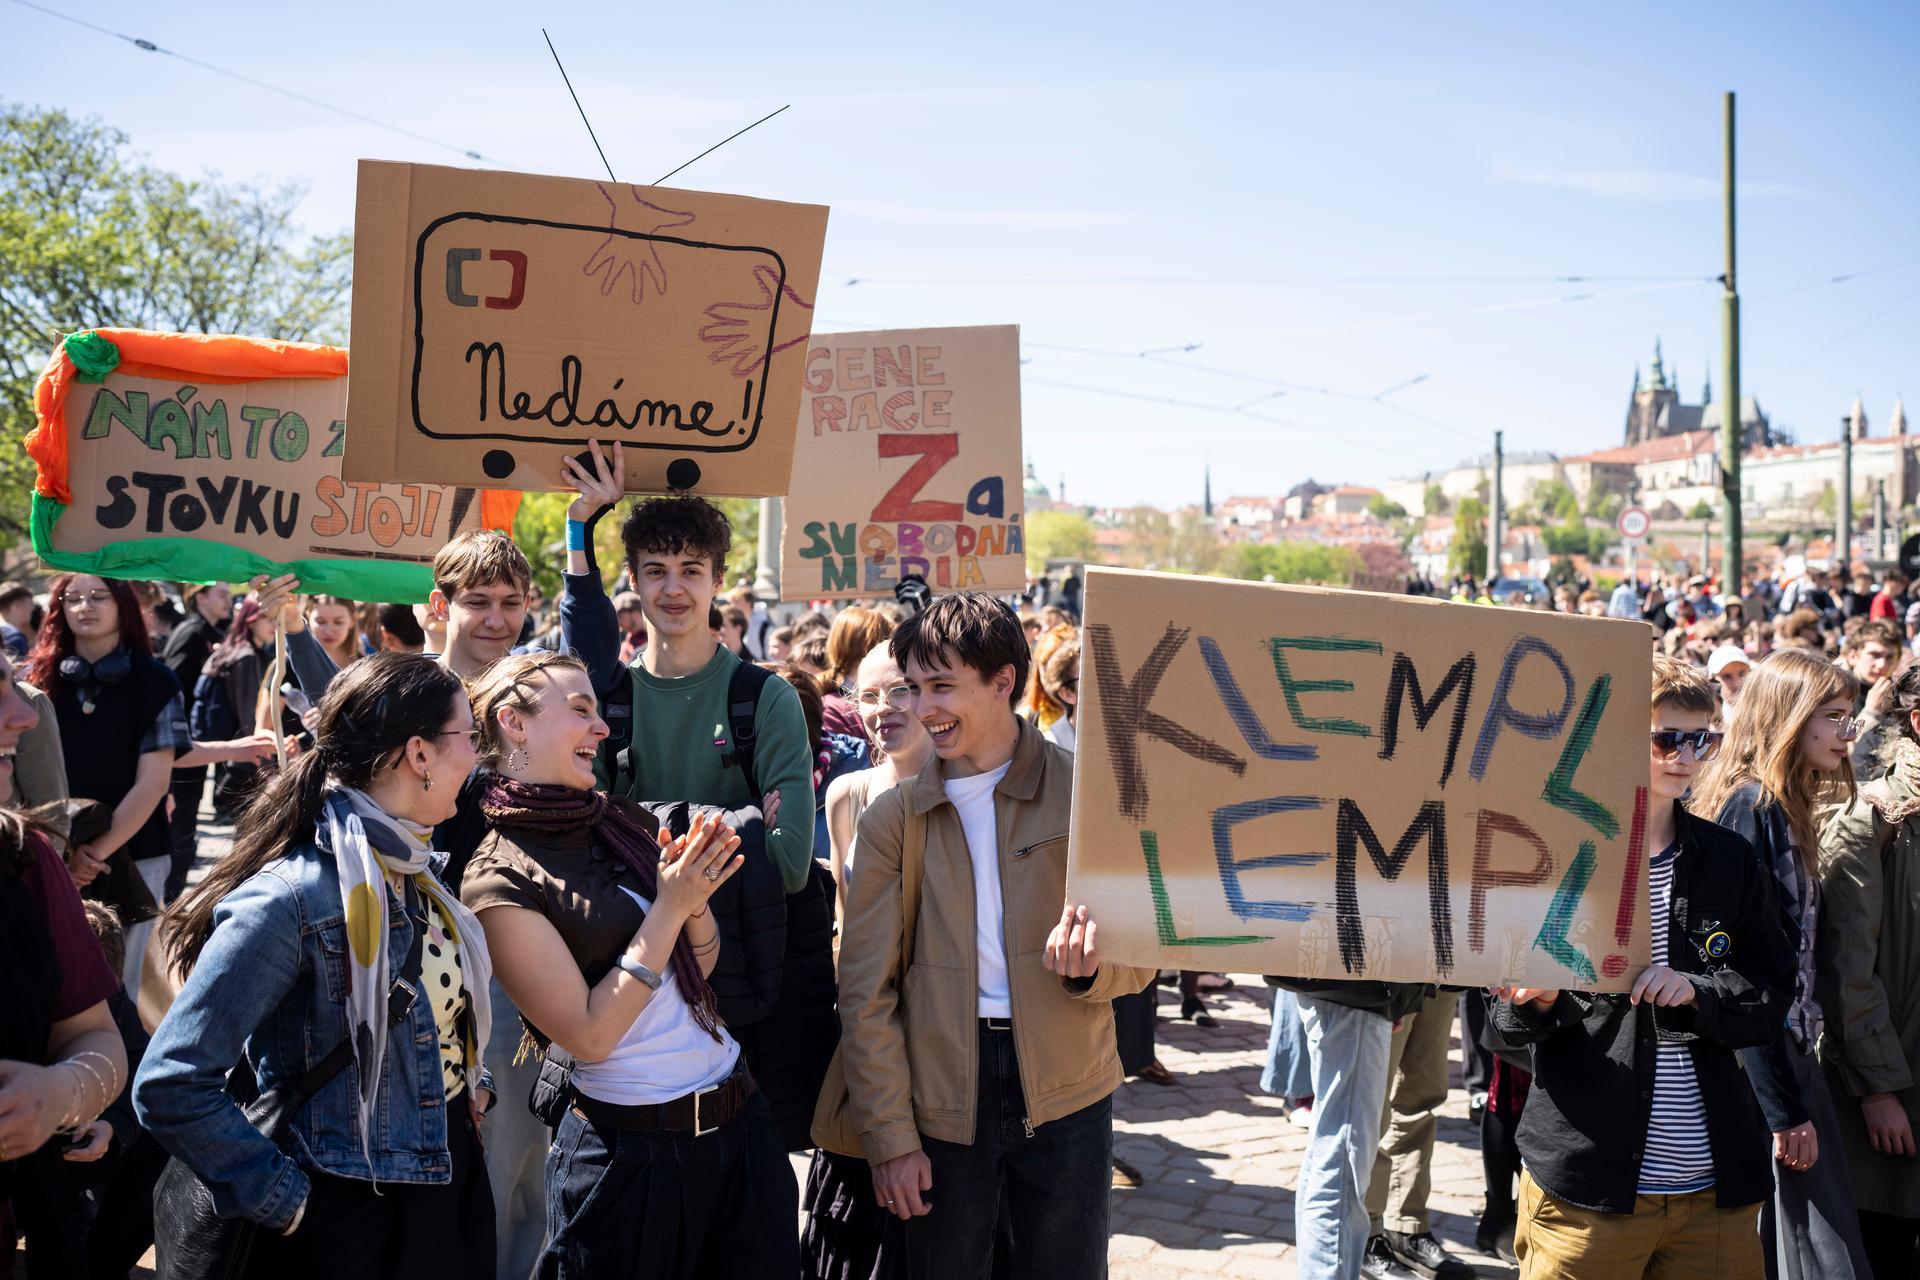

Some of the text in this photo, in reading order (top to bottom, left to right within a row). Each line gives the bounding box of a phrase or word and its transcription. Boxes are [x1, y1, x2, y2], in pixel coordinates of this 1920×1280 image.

[465, 341, 754, 437] Nedáme!
[804, 345, 945, 393] GENE
[82, 386, 232, 460] NÁM
[241, 405, 310, 462] TO
[811, 390, 954, 436] RACE
[95, 471, 300, 539] STOVKU
[870, 432, 1004, 522] Za
[799, 513, 1024, 559] SVOBODNÁ
[1085, 620, 1622, 840] KLEMPL
[1139, 786, 1649, 984] LEMPL!
